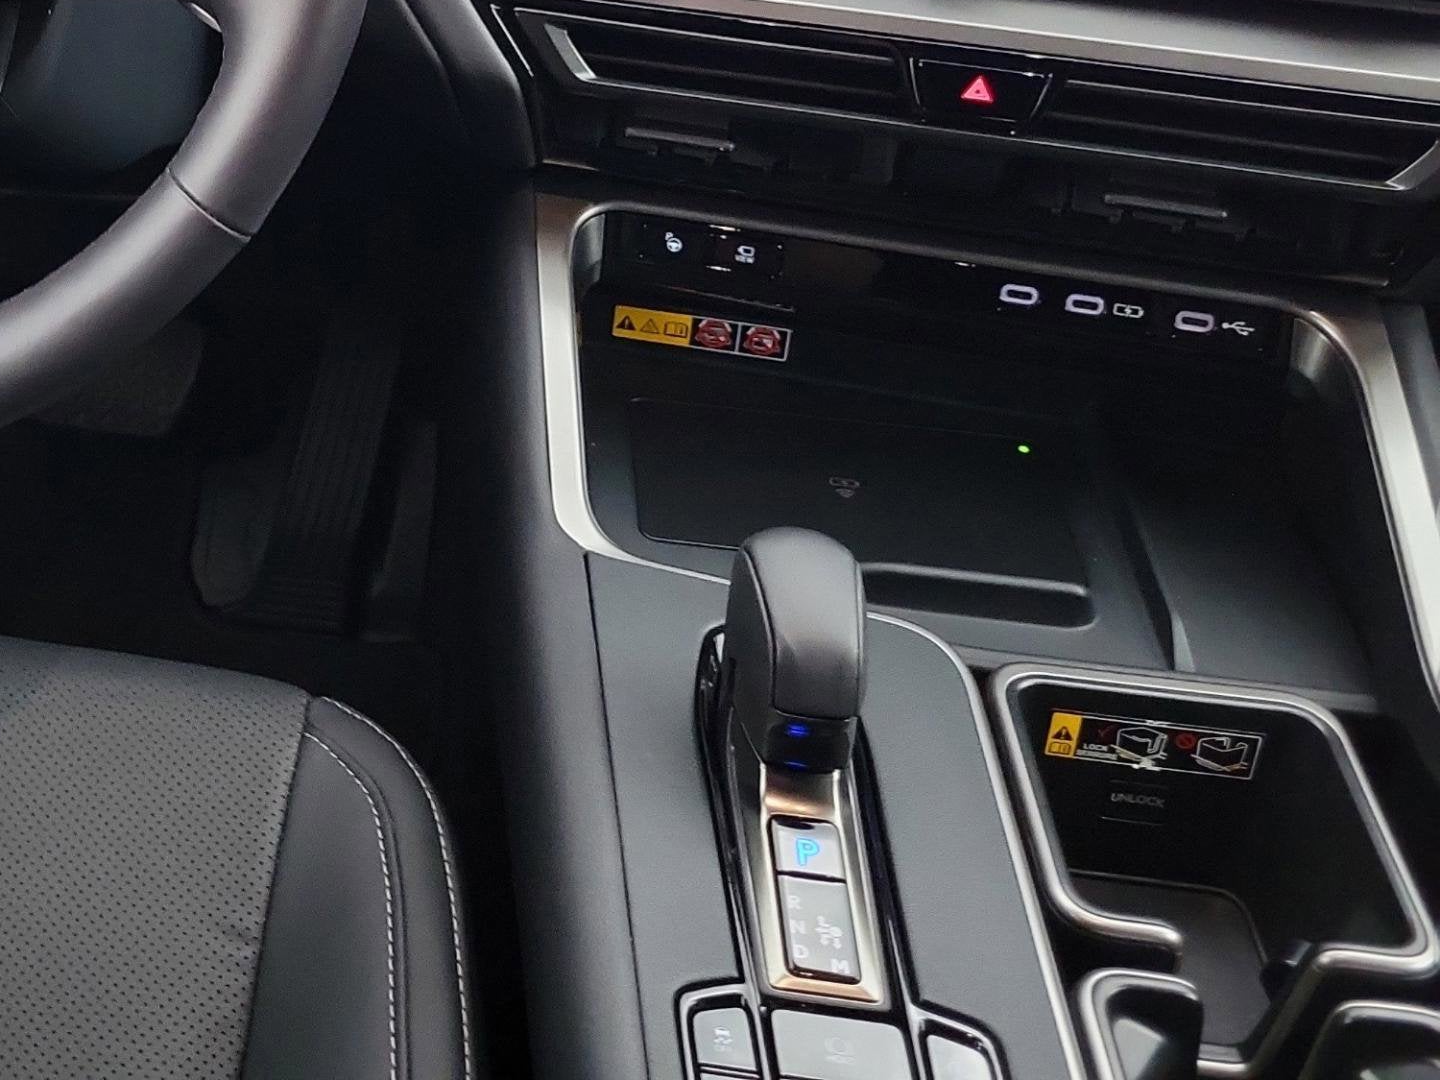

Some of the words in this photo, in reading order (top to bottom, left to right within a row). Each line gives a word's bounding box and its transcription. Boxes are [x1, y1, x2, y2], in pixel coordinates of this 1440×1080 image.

[1110, 792, 1165, 808] UNLOCK
[795, 837, 820, 867] P
[788, 895, 802, 910] R
[790, 920, 806, 935] N
[792, 944, 808, 959] D
[830, 959, 850, 974] M
